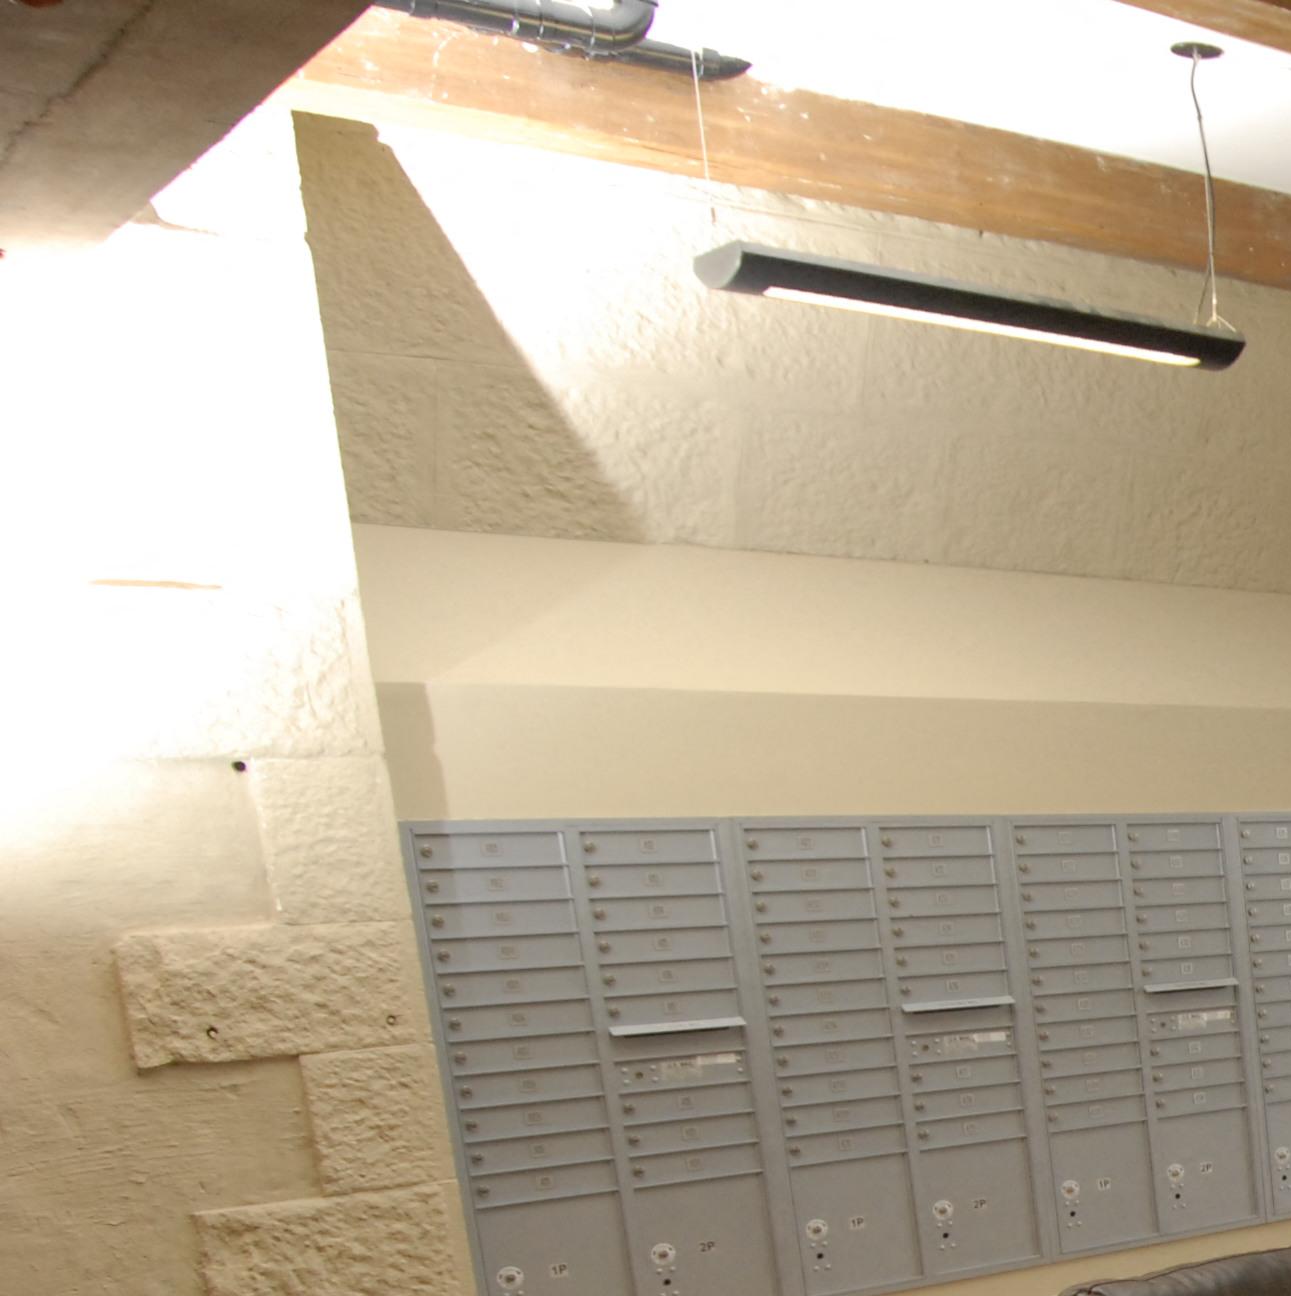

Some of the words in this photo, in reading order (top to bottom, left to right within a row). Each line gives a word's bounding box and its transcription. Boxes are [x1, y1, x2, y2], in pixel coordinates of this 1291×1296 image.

[973, 1199, 987, 1209] 2P
[851, 1217, 864, 1228] 1P
[699, 1240, 715, 1252] 2P
[551, 1264, 568, 1275] 1P
